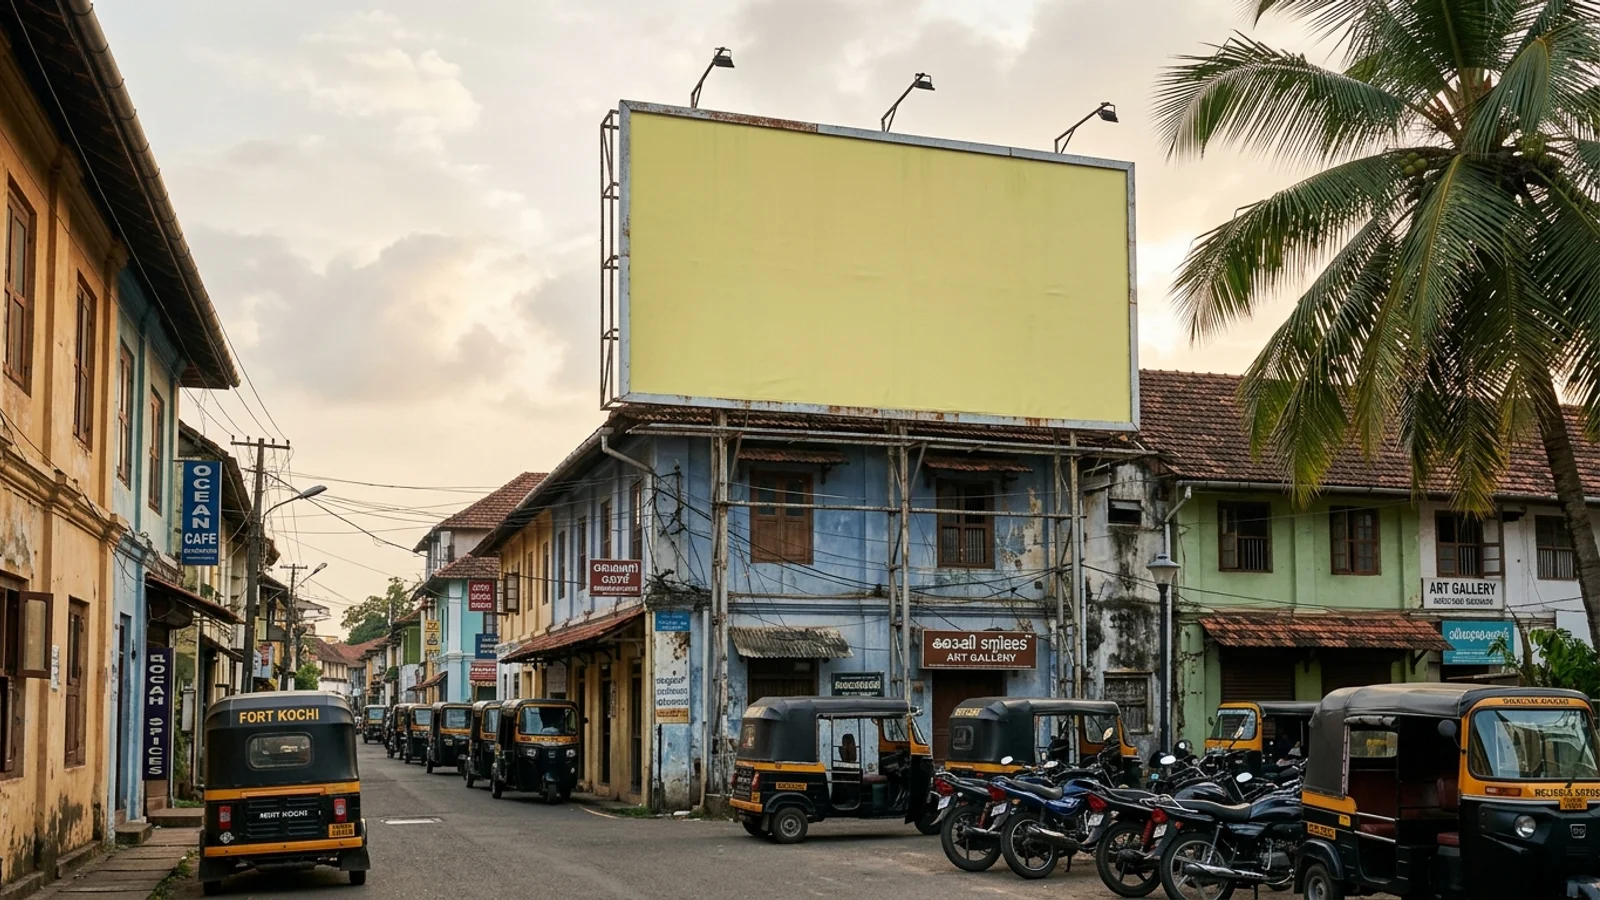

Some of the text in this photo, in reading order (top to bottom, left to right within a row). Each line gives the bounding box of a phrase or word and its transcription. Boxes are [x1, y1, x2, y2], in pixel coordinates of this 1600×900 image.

[192, 465, 211, 528] OCEAN
[185, 533, 216, 544] CAFE
[1429, 582, 1496, 595] ART GALLERY
[239, 708, 319, 724] FORT KOCHI
